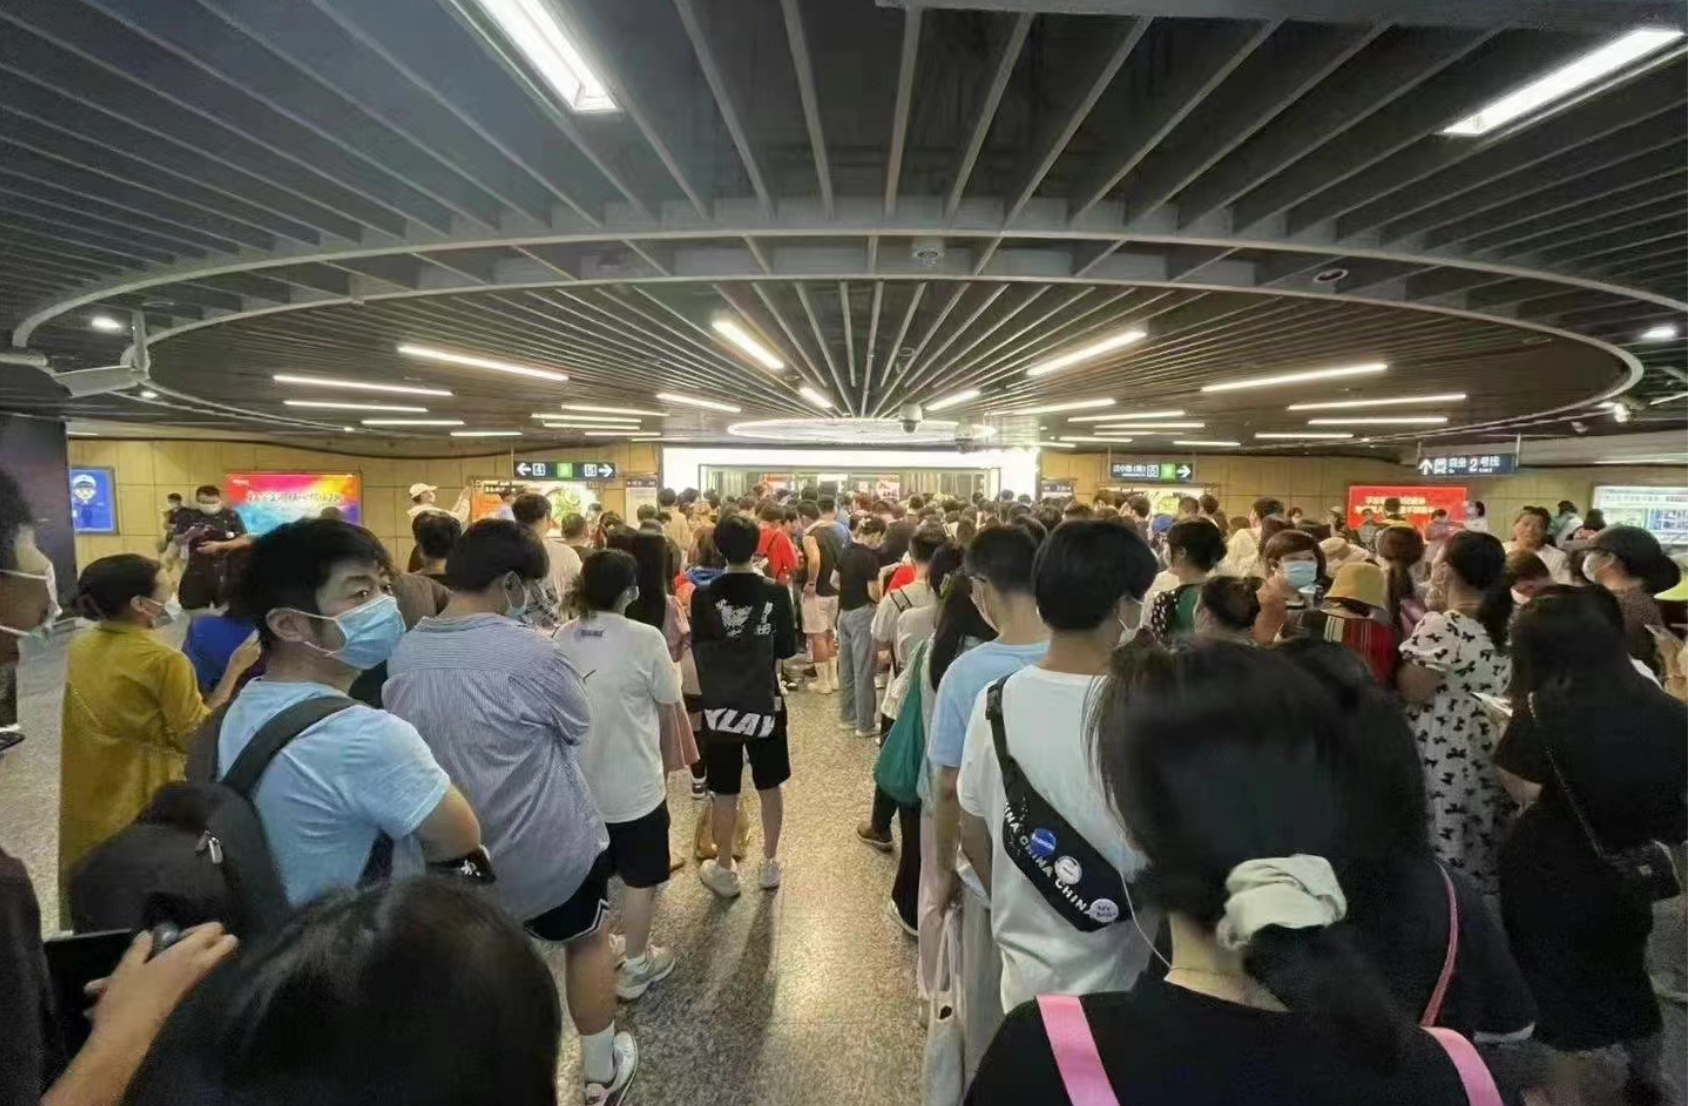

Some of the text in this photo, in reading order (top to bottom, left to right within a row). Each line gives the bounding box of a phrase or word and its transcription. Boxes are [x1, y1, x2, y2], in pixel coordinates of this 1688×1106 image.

[1469, 458, 1479, 473] 2
[1020, 835, 1053, 877] CHINA
[1054, 878, 1090, 915] CHIN
